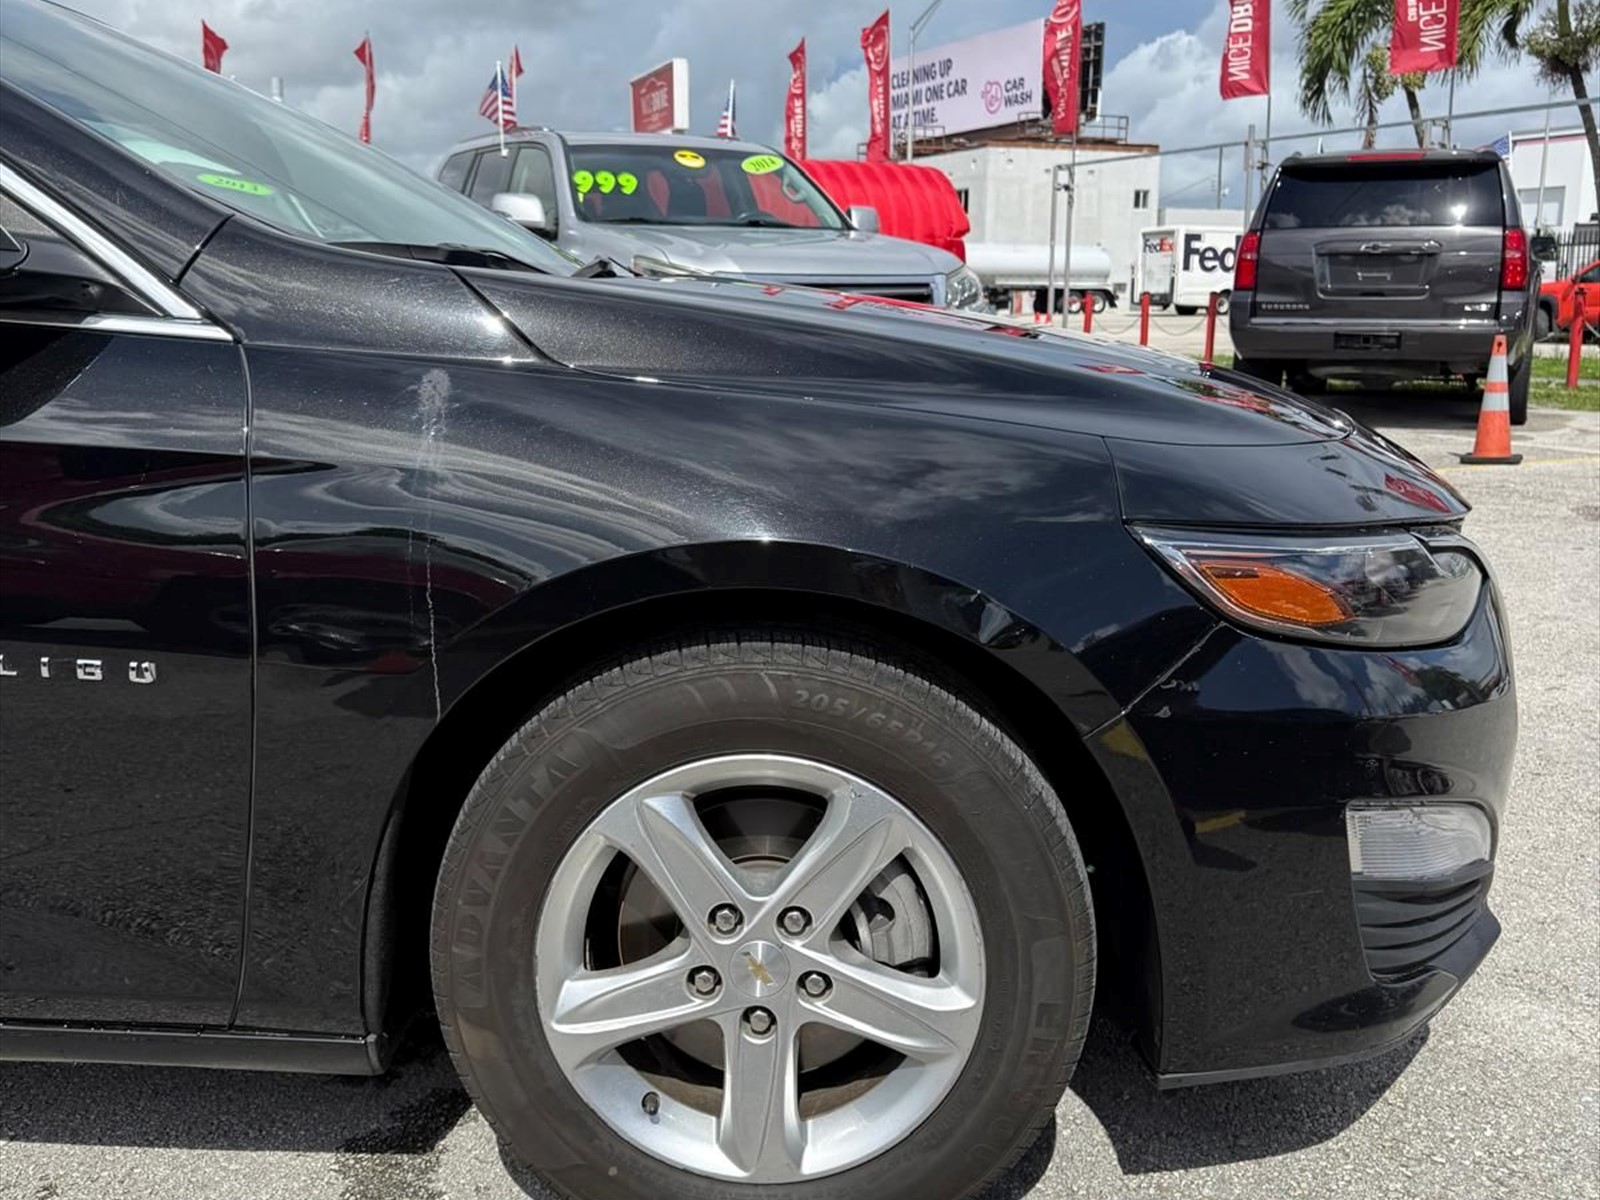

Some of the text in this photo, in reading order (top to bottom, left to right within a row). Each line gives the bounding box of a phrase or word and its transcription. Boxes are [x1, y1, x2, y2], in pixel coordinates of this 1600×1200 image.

[939, 58, 953, 78] UP
[891, 78, 968, 110] MIAMI ONE CAR
[1004, 77, 1024, 93] CAR
[1004, 88, 1032, 107] WASH
[891, 114, 902, 129] AT
[913, 107, 938, 128] TIME.
